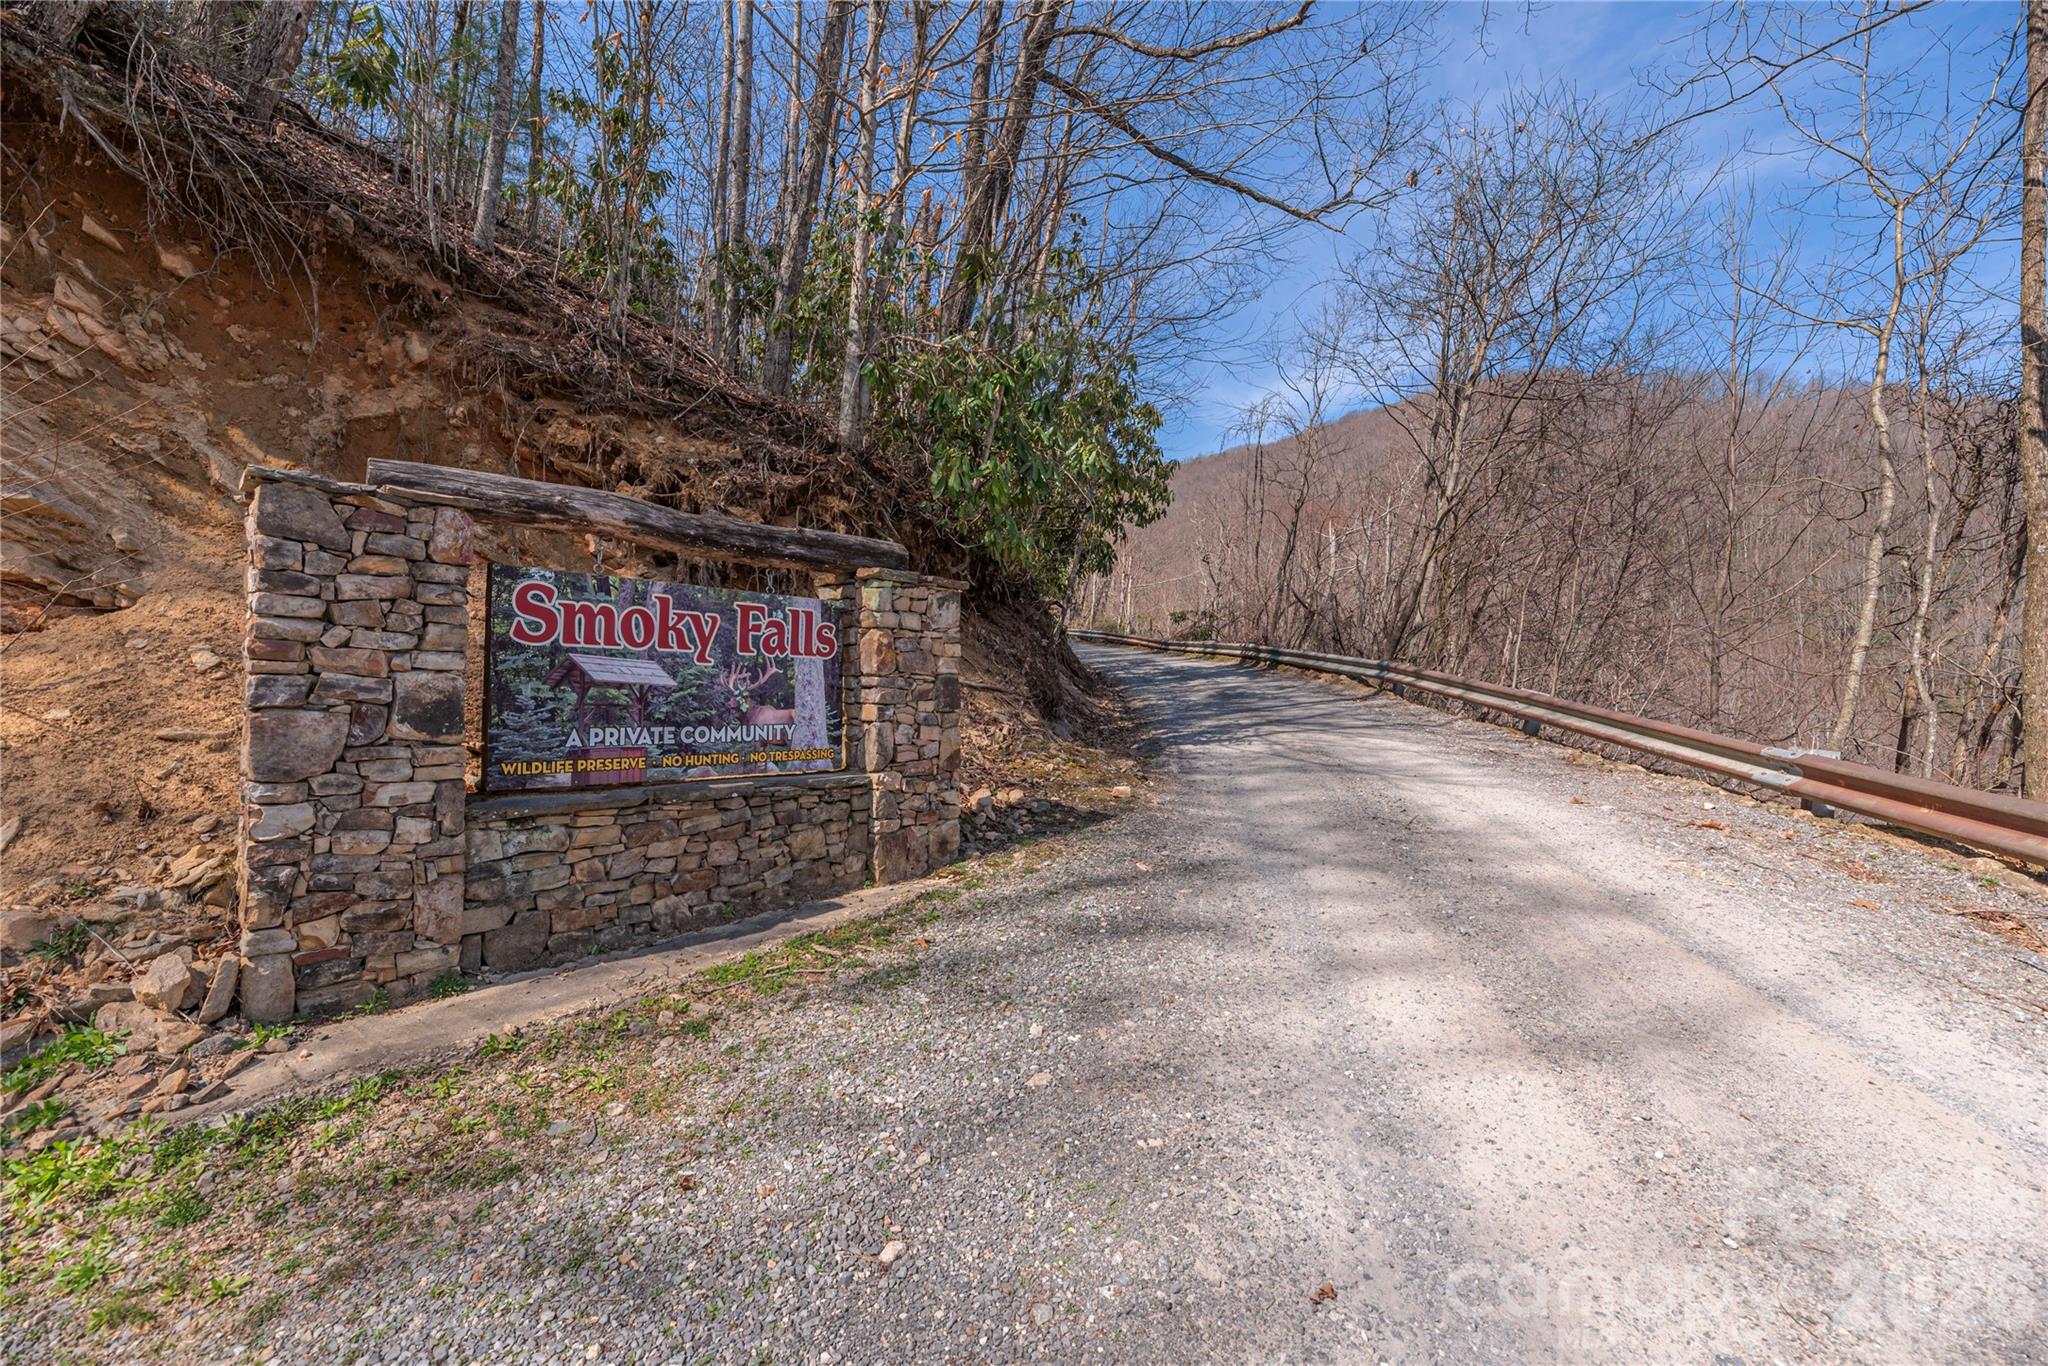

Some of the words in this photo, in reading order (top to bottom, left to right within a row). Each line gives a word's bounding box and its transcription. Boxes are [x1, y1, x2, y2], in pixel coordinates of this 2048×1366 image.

[510, 581, 721, 665] Smoky
[735, 602, 838, 660] Falls
[566, 727, 583, 748] A
[589, 725, 675, 748] PRIVATE
[680, 723, 796, 744] COMMUNITY
[500, 760, 574, 776] WILDLIFE
[577, 756, 646, 773] PRESERVE
[662, 756, 684, 768] NO
[686, 752, 739, 767] HUNTING
[750, 751, 766, 763] NO
[768, 749, 835, 762] TRESPASSING
